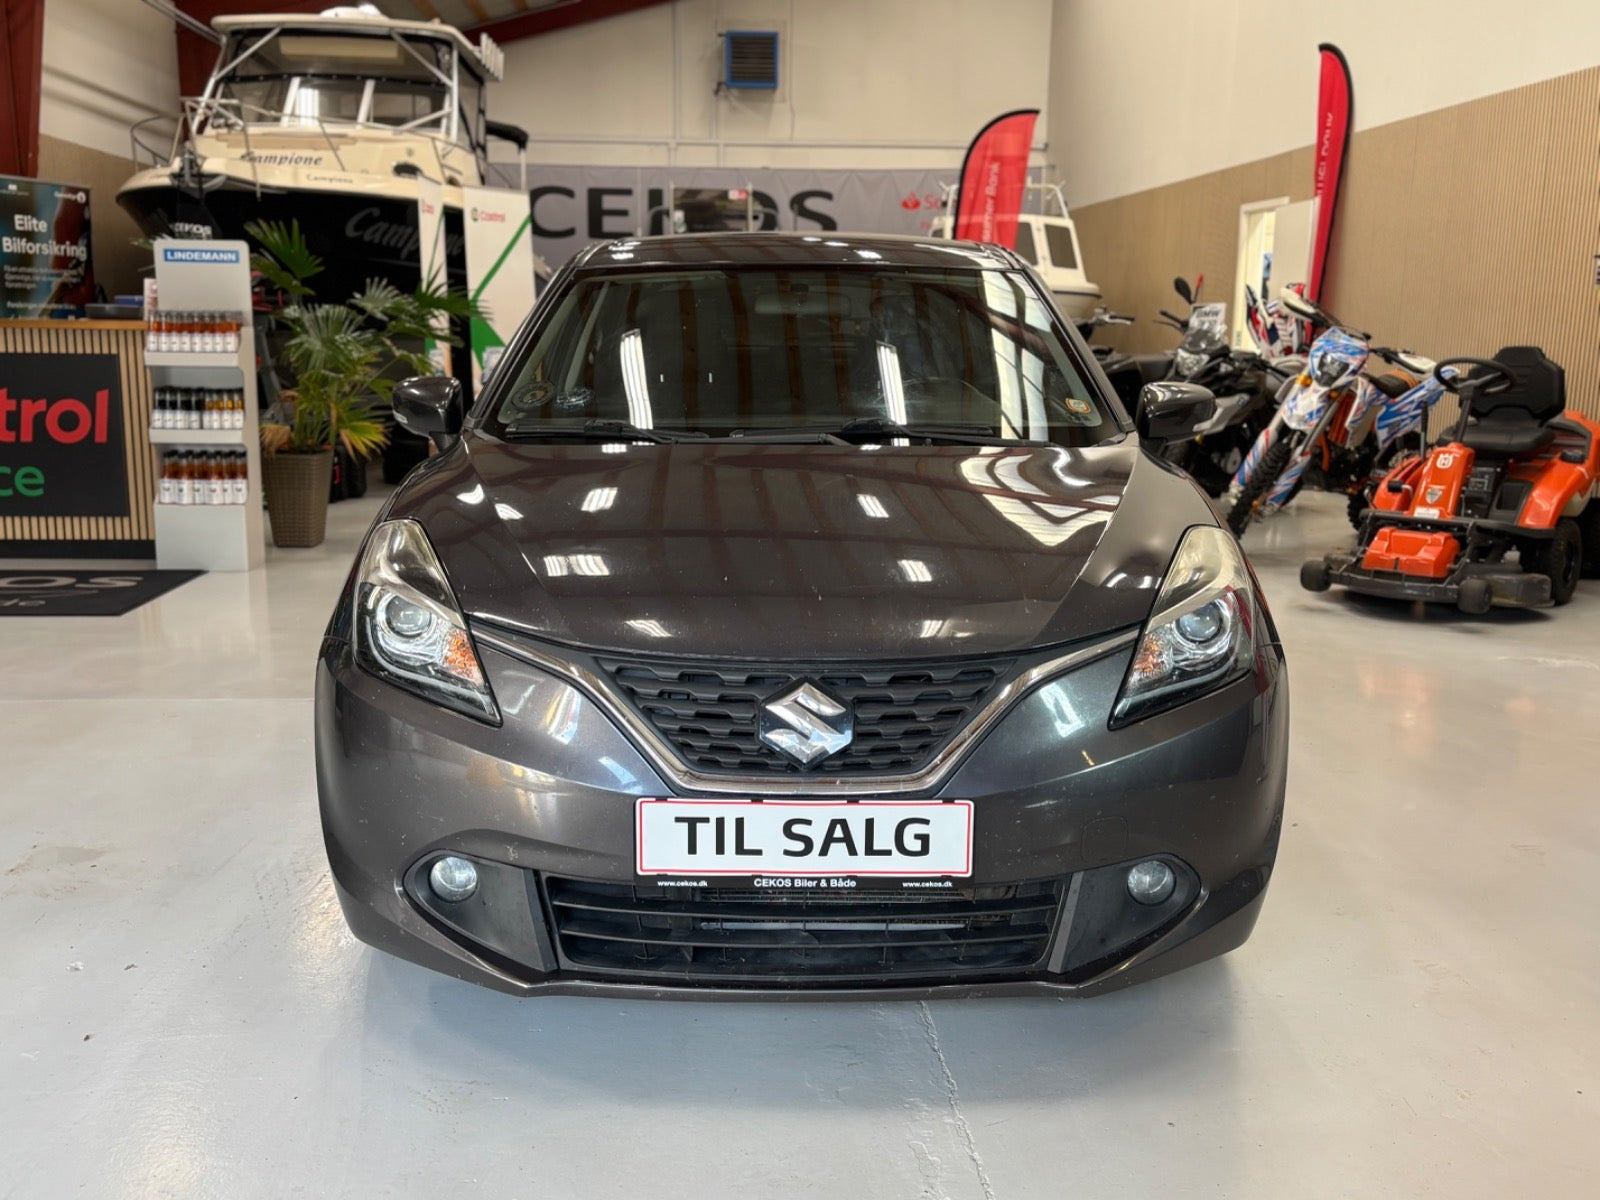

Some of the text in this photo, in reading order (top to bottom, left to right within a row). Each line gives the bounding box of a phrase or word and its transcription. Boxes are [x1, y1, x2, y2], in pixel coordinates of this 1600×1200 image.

[14, 213, 48, 232] Elite
[2, 236, 87, 261] Bilforsikring
[166, 250, 237, 262] LINDEMANN
[674, 816, 931, 858] TIL SALG
[657, 879, 709, 888] www.cekos.dk
[753, 877, 857, 888] CEKOS Biler & Både
[902, 880, 953, 889] www.cekos.dk
